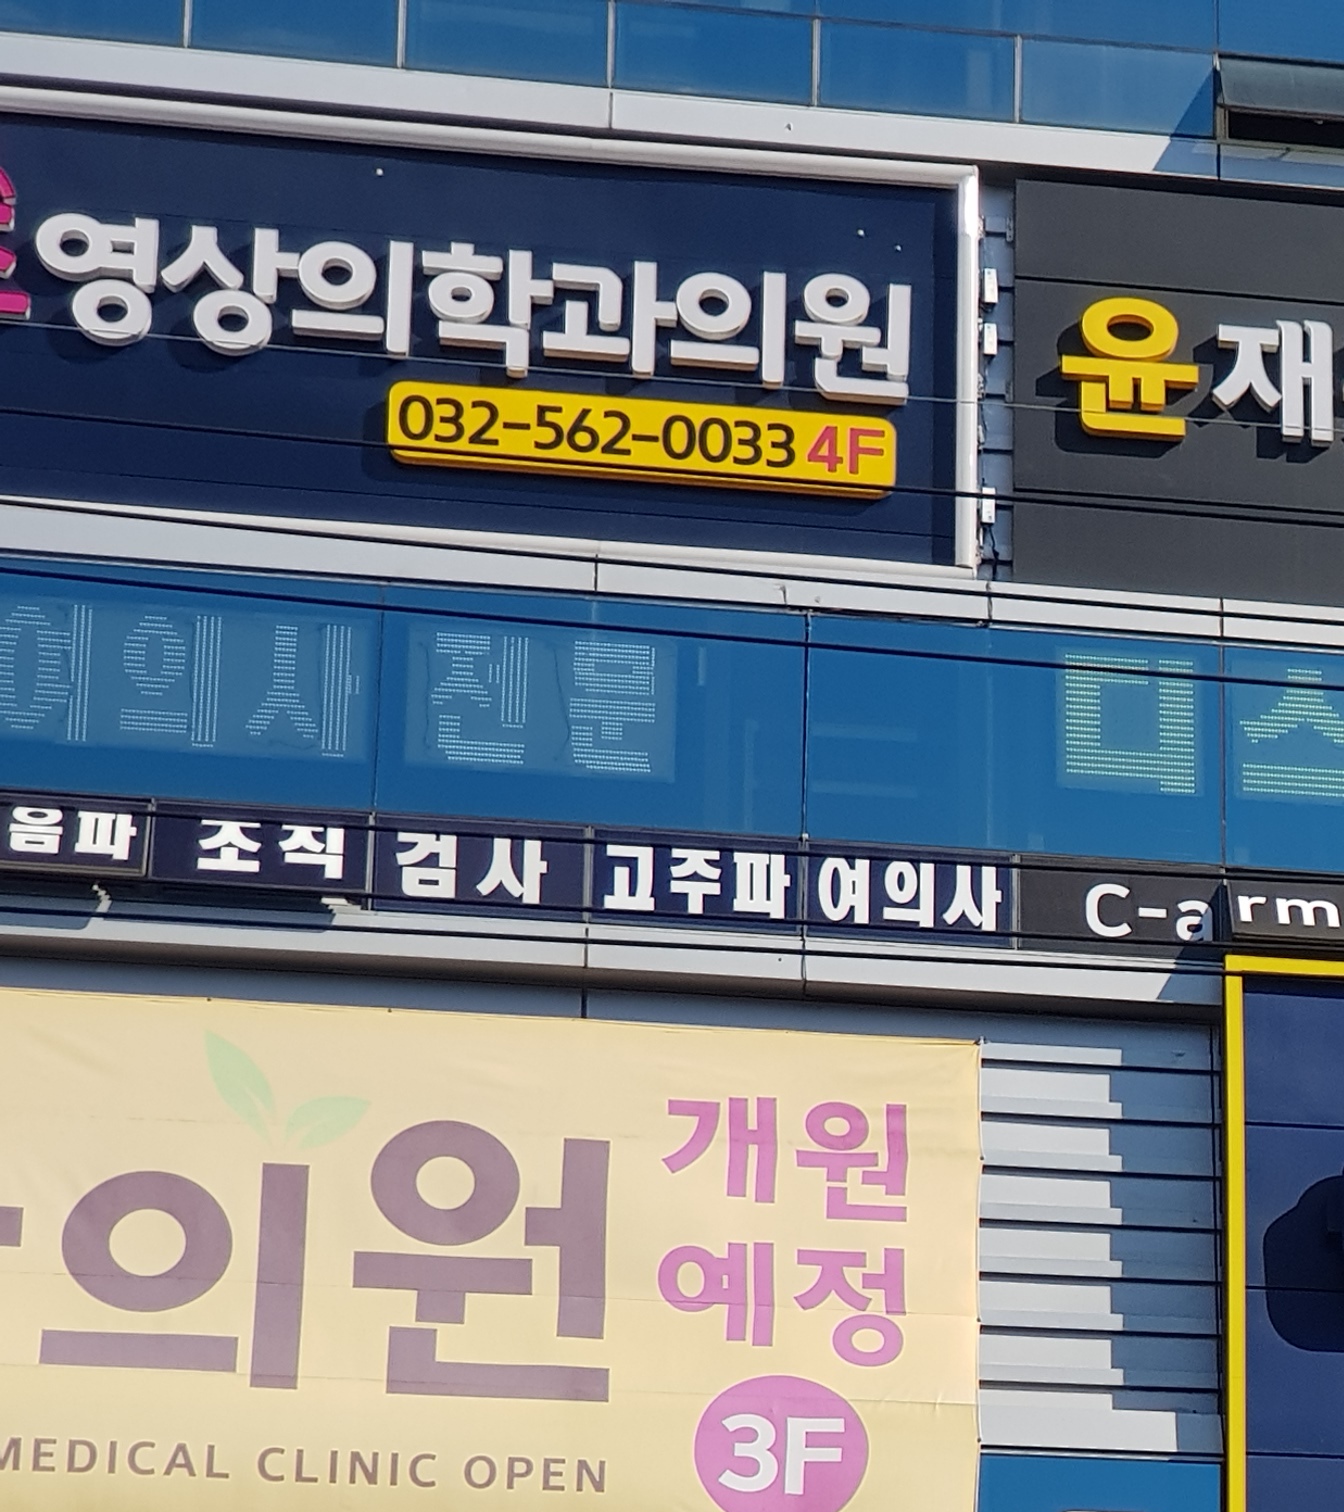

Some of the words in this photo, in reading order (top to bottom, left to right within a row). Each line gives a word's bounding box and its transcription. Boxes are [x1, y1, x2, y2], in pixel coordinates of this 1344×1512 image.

[35, 212, 912, 405] 영상의학과의원
[398, 394, 797, 468] 032-562-0033
[806, 424, 886, 475] 4F
[604, 844, 790, 919] 고주파
[817, 857, 1002, 933] 여의사
[662, 1096, 908, 1222] 개원
[0, 1120, 611, 1403] 의원
[657, 1241, 907, 1367] 예정
[257, 1446, 438, 1490] CLINIC
[464, 1455, 608, 1495] OPEN
[718, 1413, 846, 1497] 3F
